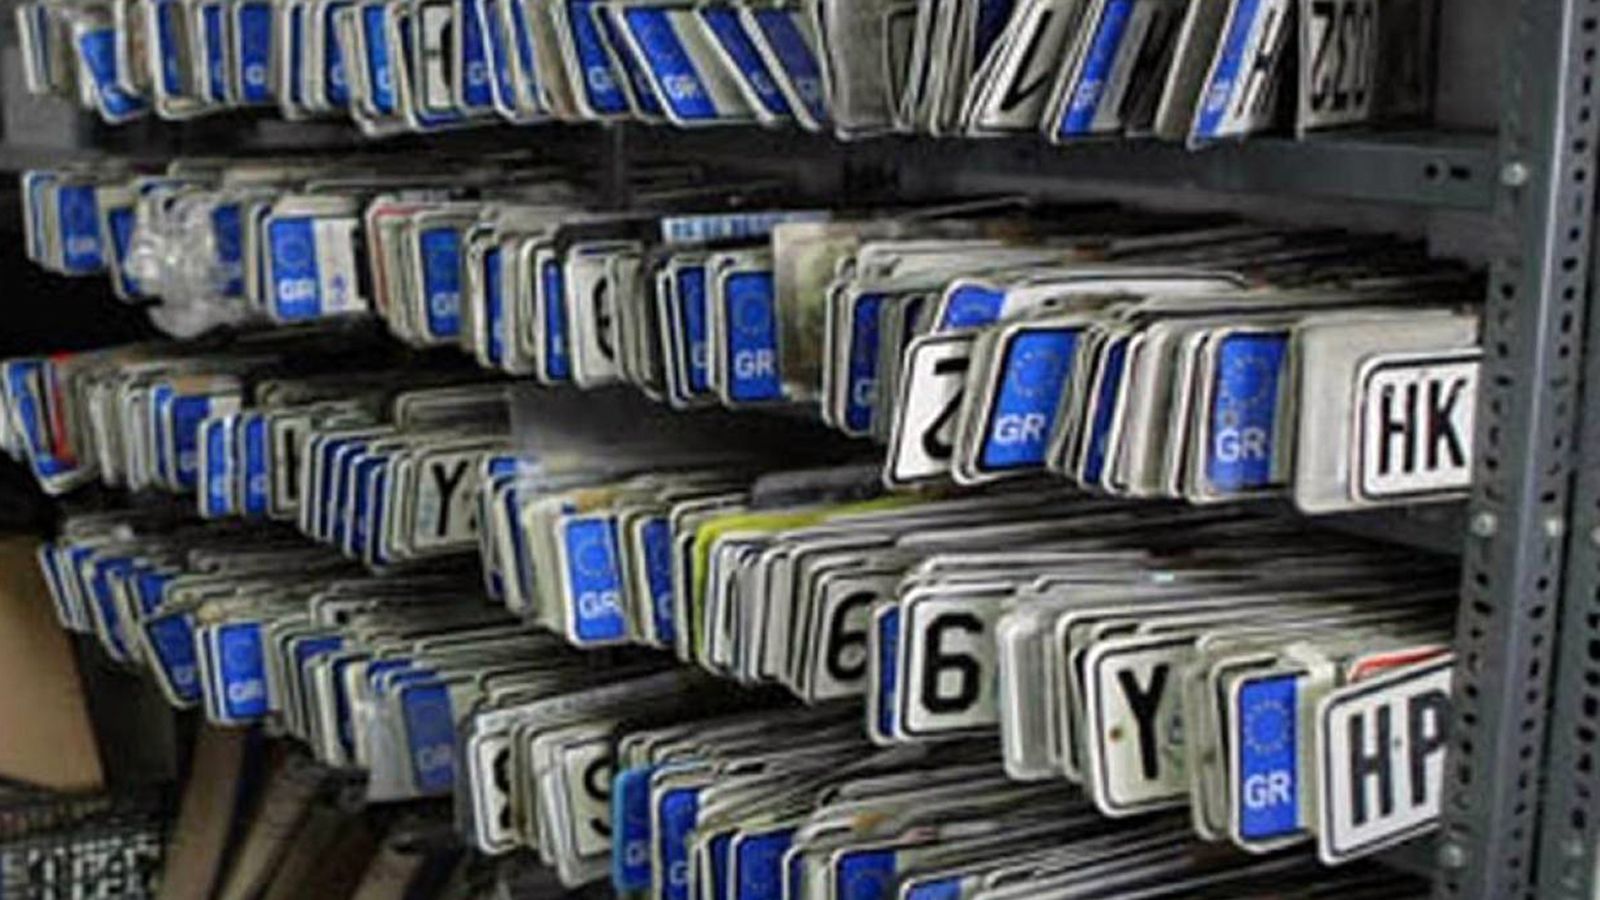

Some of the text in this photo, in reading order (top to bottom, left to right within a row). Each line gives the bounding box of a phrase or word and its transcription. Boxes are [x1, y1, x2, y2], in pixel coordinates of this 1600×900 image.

[734, 348, 777, 379] GR
[994, 412, 1046, 446] GR
[1216, 425, 1266, 463] GR
[1378, 378, 1467, 476] HK
[920, 611, 985, 715] 6
[1117, 661, 1171, 782] Y
[1244, 769, 1293, 811] GR
[1347, 688, 1452, 828] HP
